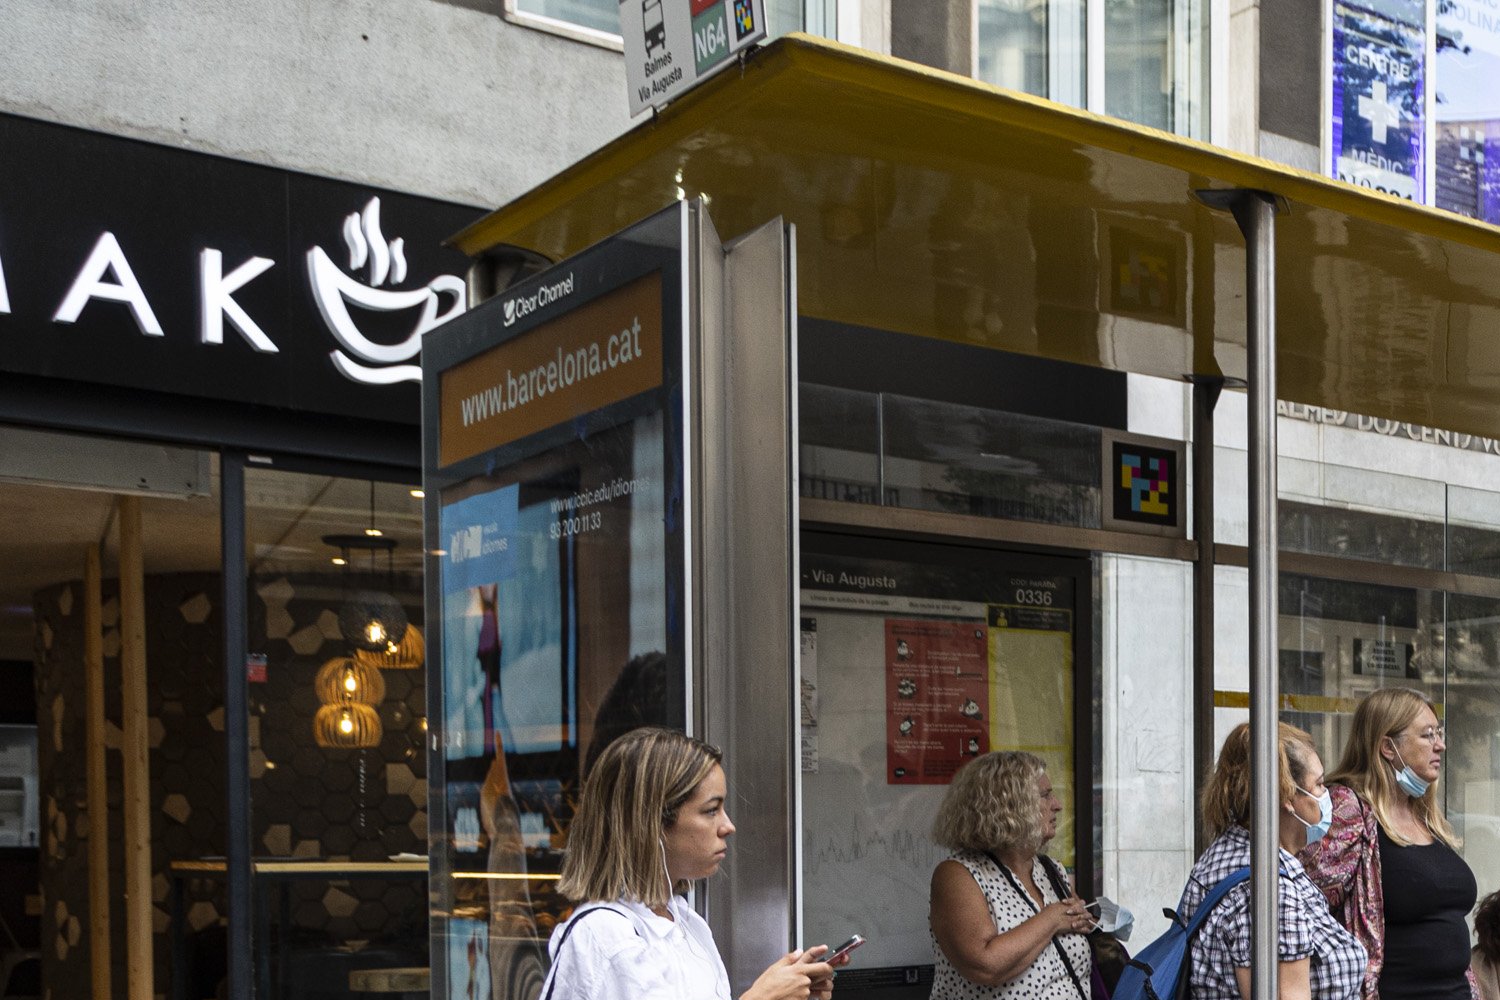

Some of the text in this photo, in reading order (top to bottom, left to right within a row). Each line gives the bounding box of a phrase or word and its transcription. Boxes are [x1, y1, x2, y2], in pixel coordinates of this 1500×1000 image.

[695, 16, 726, 62] N64
[644, 51, 673, 78] Balmes
[1346, 44, 1411, 79] CENTRE
[638, 66, 683, 102] Via Augusta
[515, 272, 574, 318] Clear Channel
[461, 315, 643, 427] www.barcelona.cat
[563, 516, 581, 535] 200
[582, 514, 590, 531] 11
[590, 511, 601, 529] 33
[811, 569, 835, 584] Via
[838, 571, 897, 589] Augusta
[1015, 588, 1053, 606] 0336
